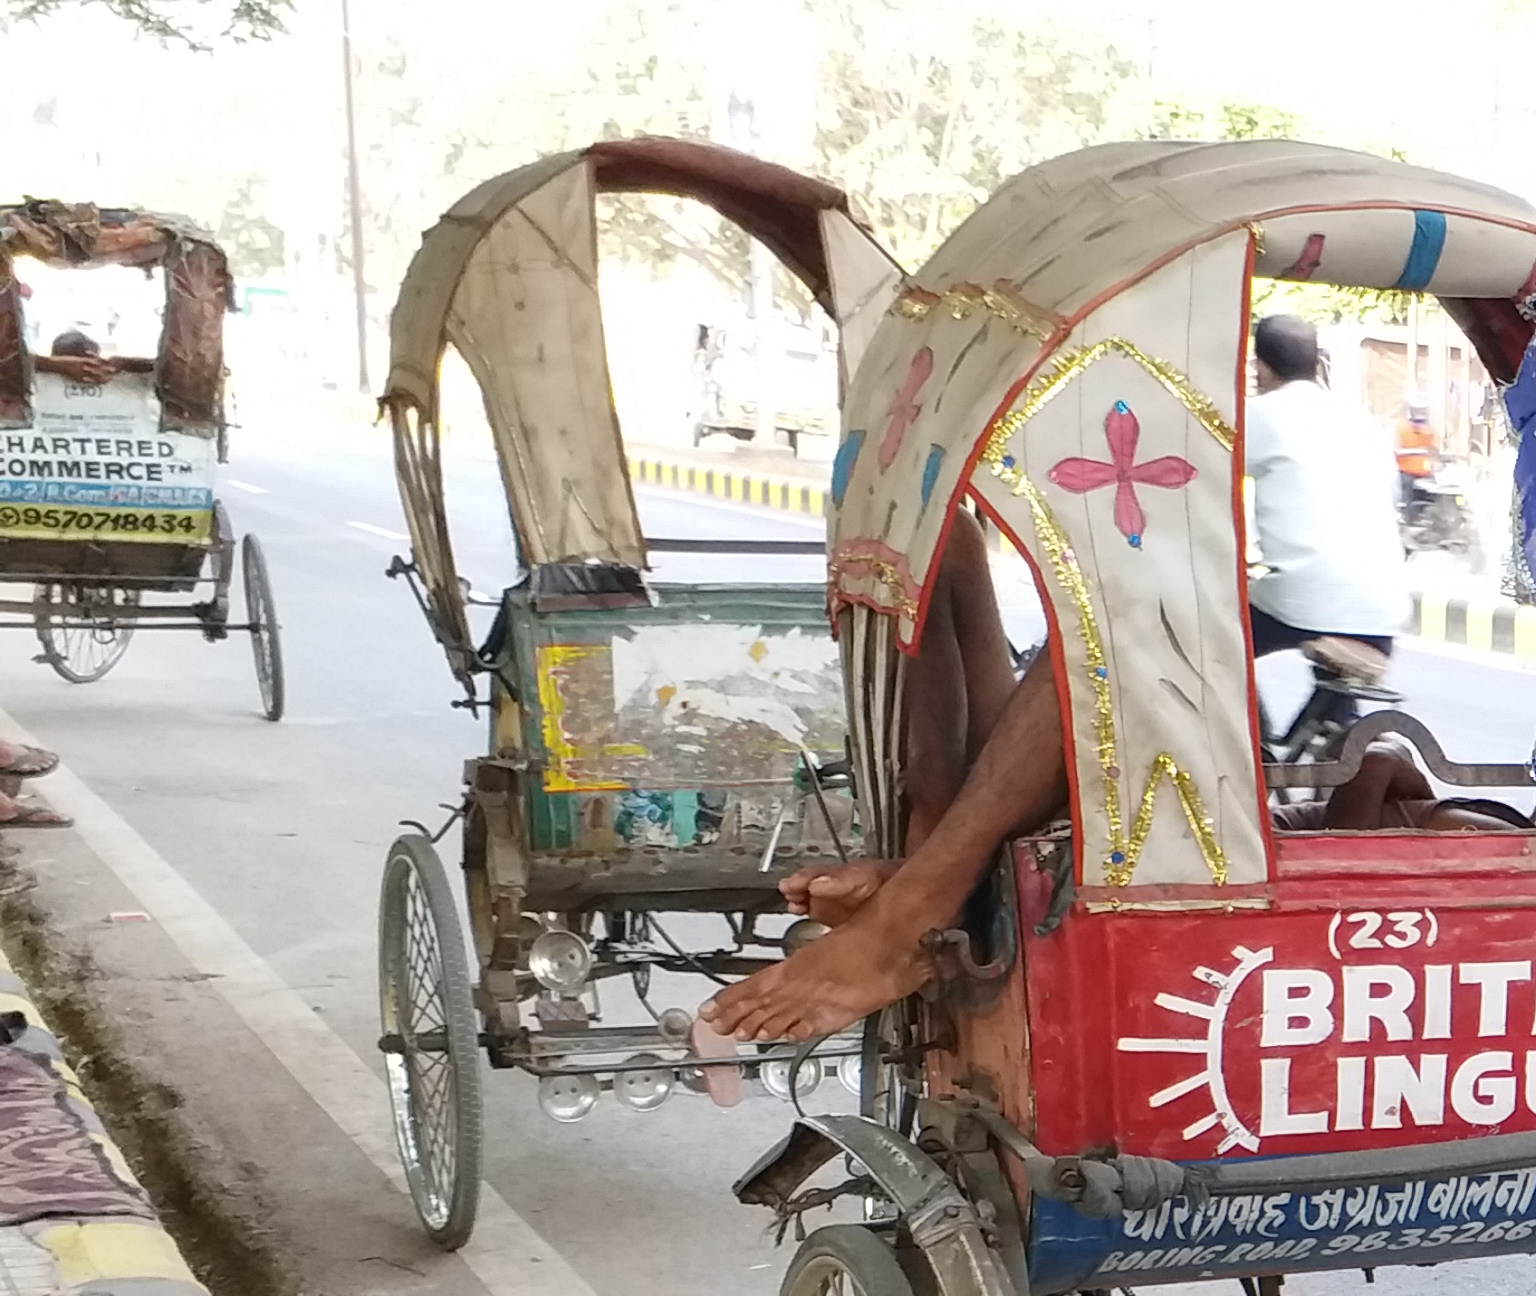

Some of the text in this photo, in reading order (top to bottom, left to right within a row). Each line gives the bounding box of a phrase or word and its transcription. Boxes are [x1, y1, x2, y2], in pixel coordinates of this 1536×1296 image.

[0, 435, 175, 458] HARTERED
[23, 507, 197, 534] 9570718434
[1327, 908, 1439, 960] (23)
[1098, 1244, 1228, 1274] BORING
